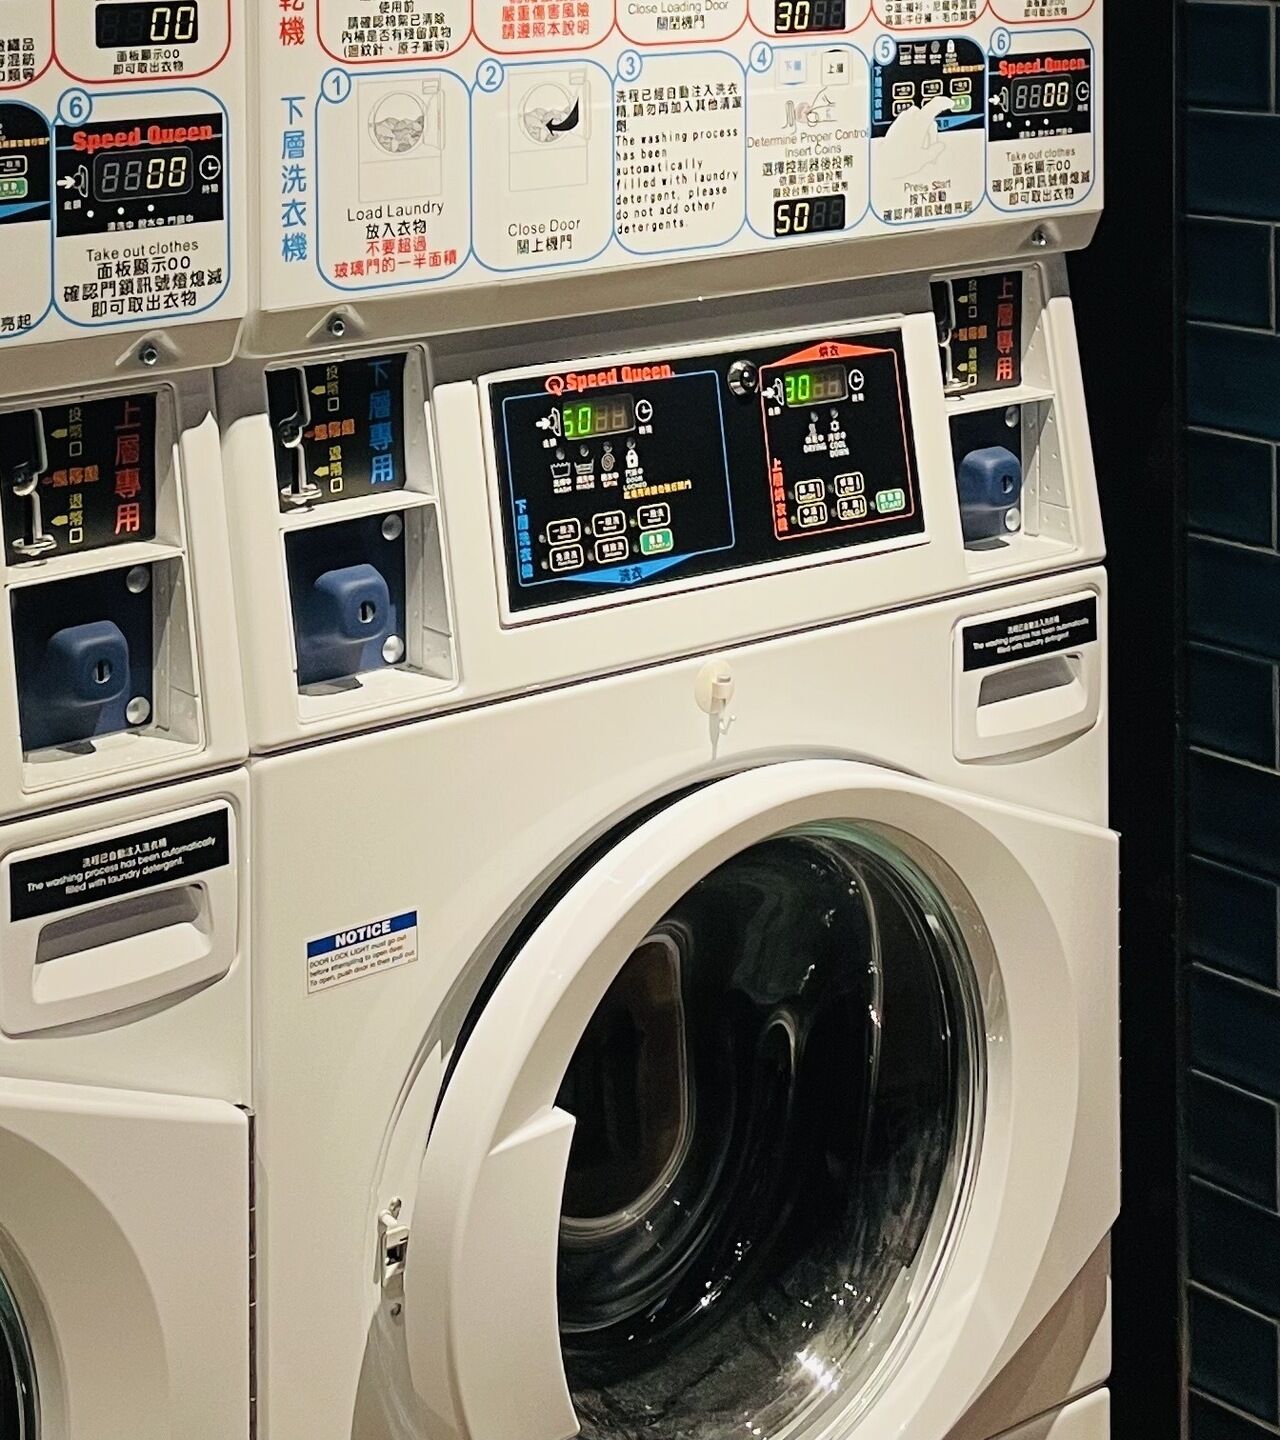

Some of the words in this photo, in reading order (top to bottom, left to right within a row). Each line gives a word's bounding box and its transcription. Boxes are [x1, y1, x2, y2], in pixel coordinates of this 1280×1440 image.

[628, 3, 657, 14] Close
[661, 2, 701, 14] Loading
[705, 0, 728, 10] Door
[776, 1, 810, 31] 30
[999, 59, 1040, 76] Speed
[1045, 57, 1085, 71] Queen
[73, 129, 141, 154] Speed
[148, 126, 212, 143] Queen
[281, 97, 307, 262] 下層洗衣機
[348, 206, 382, 221] Load
[387, 201, 444, 218] Laundry
[776, 203, 808, 233] 50
[366, 220, 426, 239] 放入衣物
[508, 223, 545, 237] Close
[550, 219, 581, 232] Door
[87, 248, 119, 262] Take
[123, 246, 145, 259] out
[149, 241, 198, 257] clothes
[567, 369, 618, 393] Speed
[27, 882, 44, 892] The
[46, 873, 83, 888] washing
[85, 864, 118, 880] process
[120, 858, 136, 869] has
[138, 852, 160, 865] been
[88, 877, 106, 889] with
[108, 869, 141, 884] laundry
[335, 920, 391, 948] NOTICE
